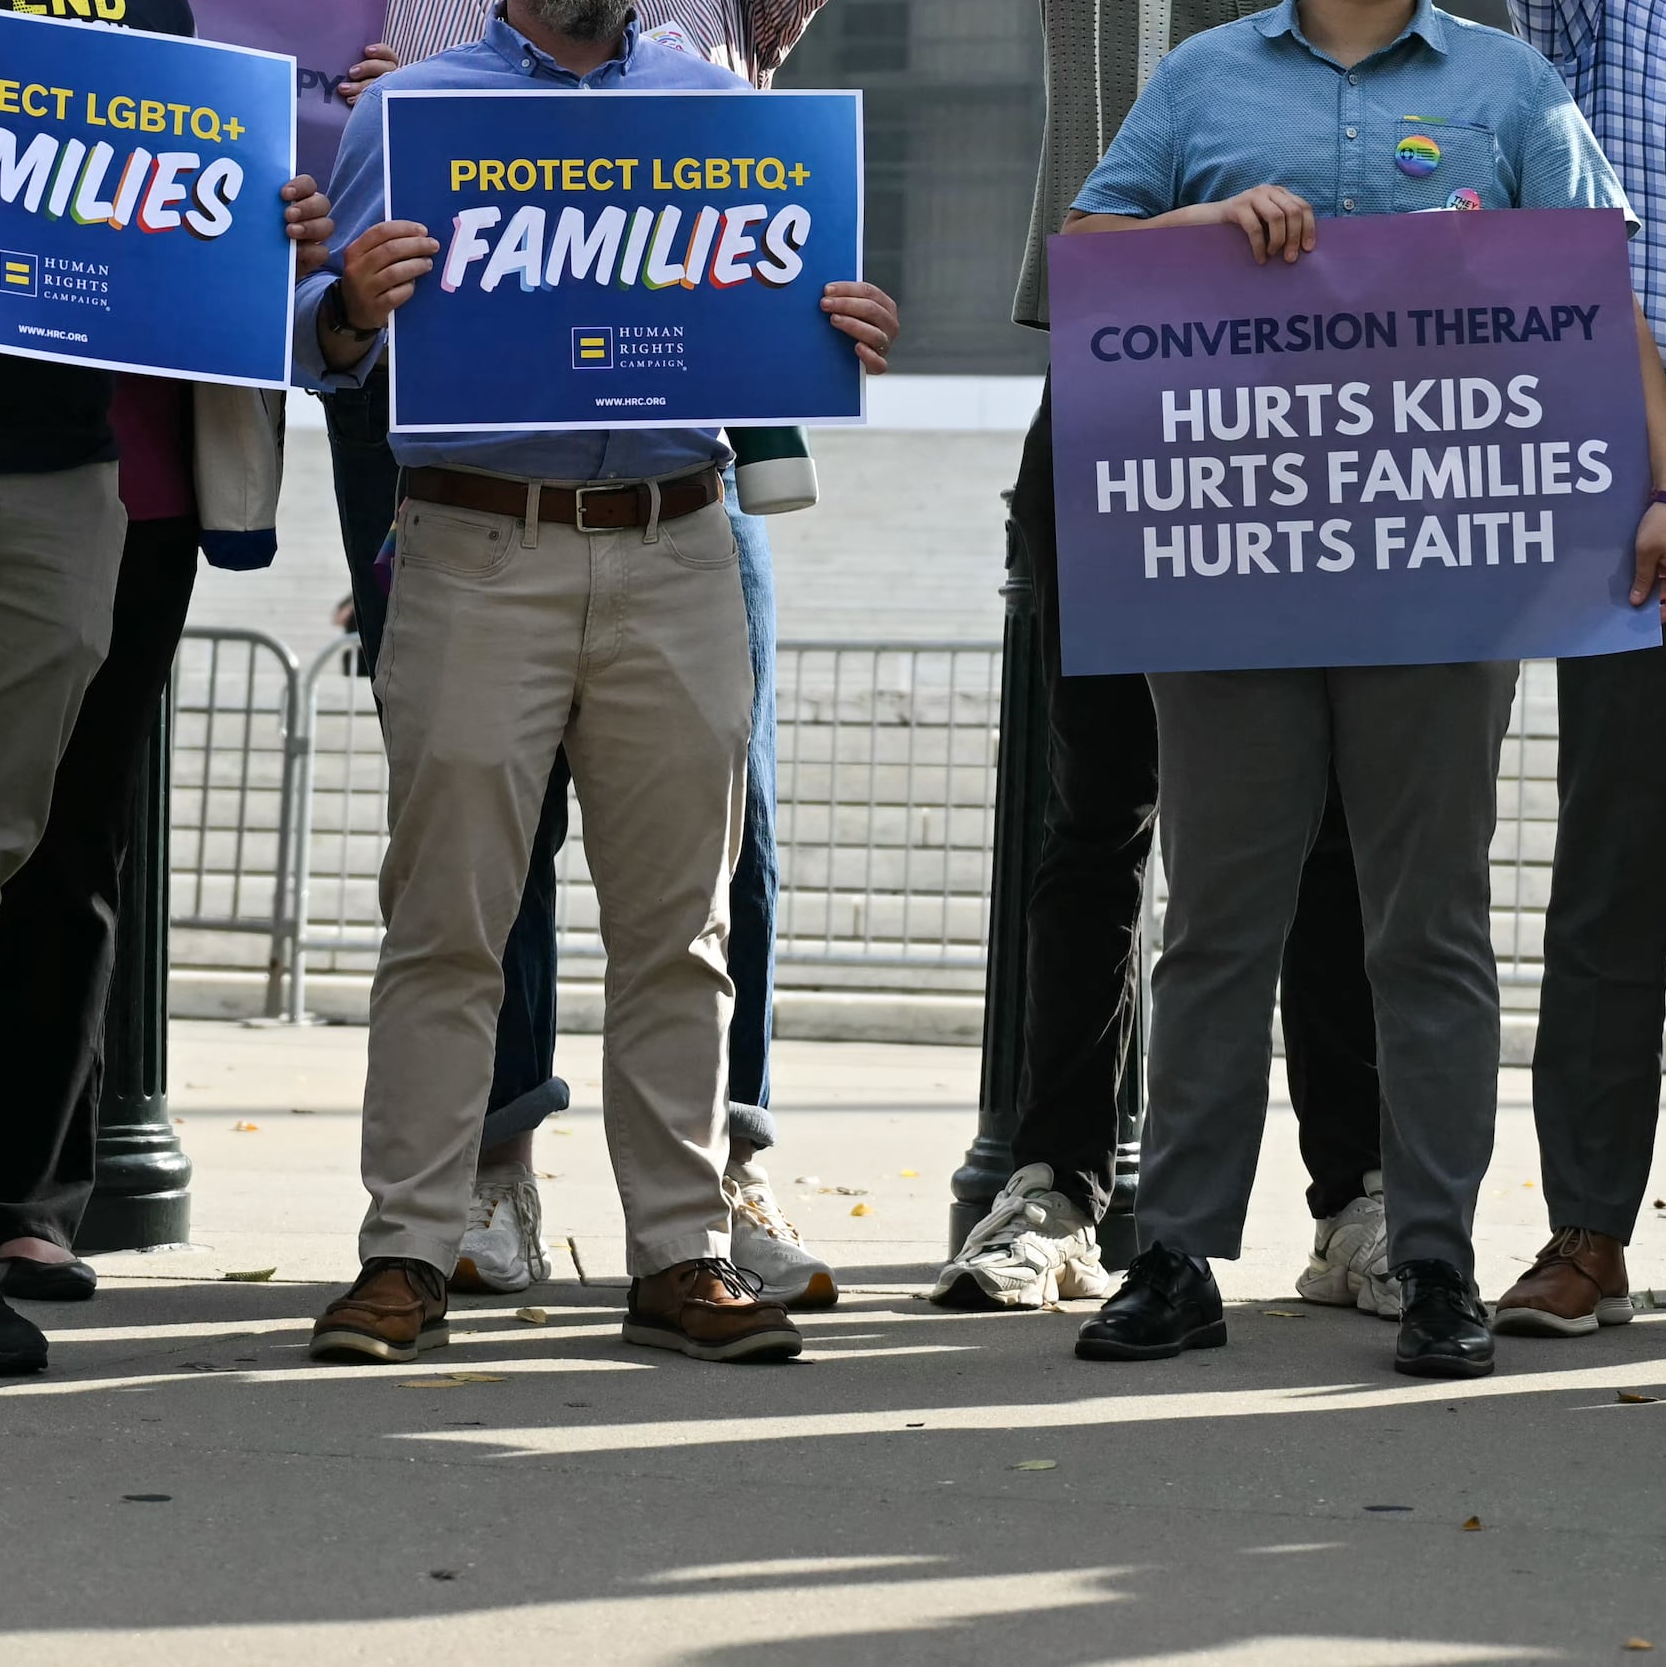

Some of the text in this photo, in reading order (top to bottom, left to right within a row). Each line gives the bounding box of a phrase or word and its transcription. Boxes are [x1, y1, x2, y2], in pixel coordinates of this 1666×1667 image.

[86, 91, 246, 142] LGBTQ+
[450, 157, 811, 192] PROTECT LGBTQ+
[1453, 195, 1478, 210] THEY
[440, 204, 812, 294] FAMILIES
[44, 257, 109, 276] HUMAN
[44, 275, 109, 293] RIGHTS
[18, 324, 88, 343] WWW.HRC.ORG
[619, 326, 684, 338] HUMAN
[1090, 304, 1601, 363] CONVERSION THERAPY
[619, 342, 684, 355] RIGHTS
[595, 397, 666, 407] WWW.HRC.ORG
[1162, 374, 1543, 443] HURTS KIDS
[1095, 437, 1613, 514] HURTS FAMILIES
[1143, 510, 1555, 579] HURTS FAITH
